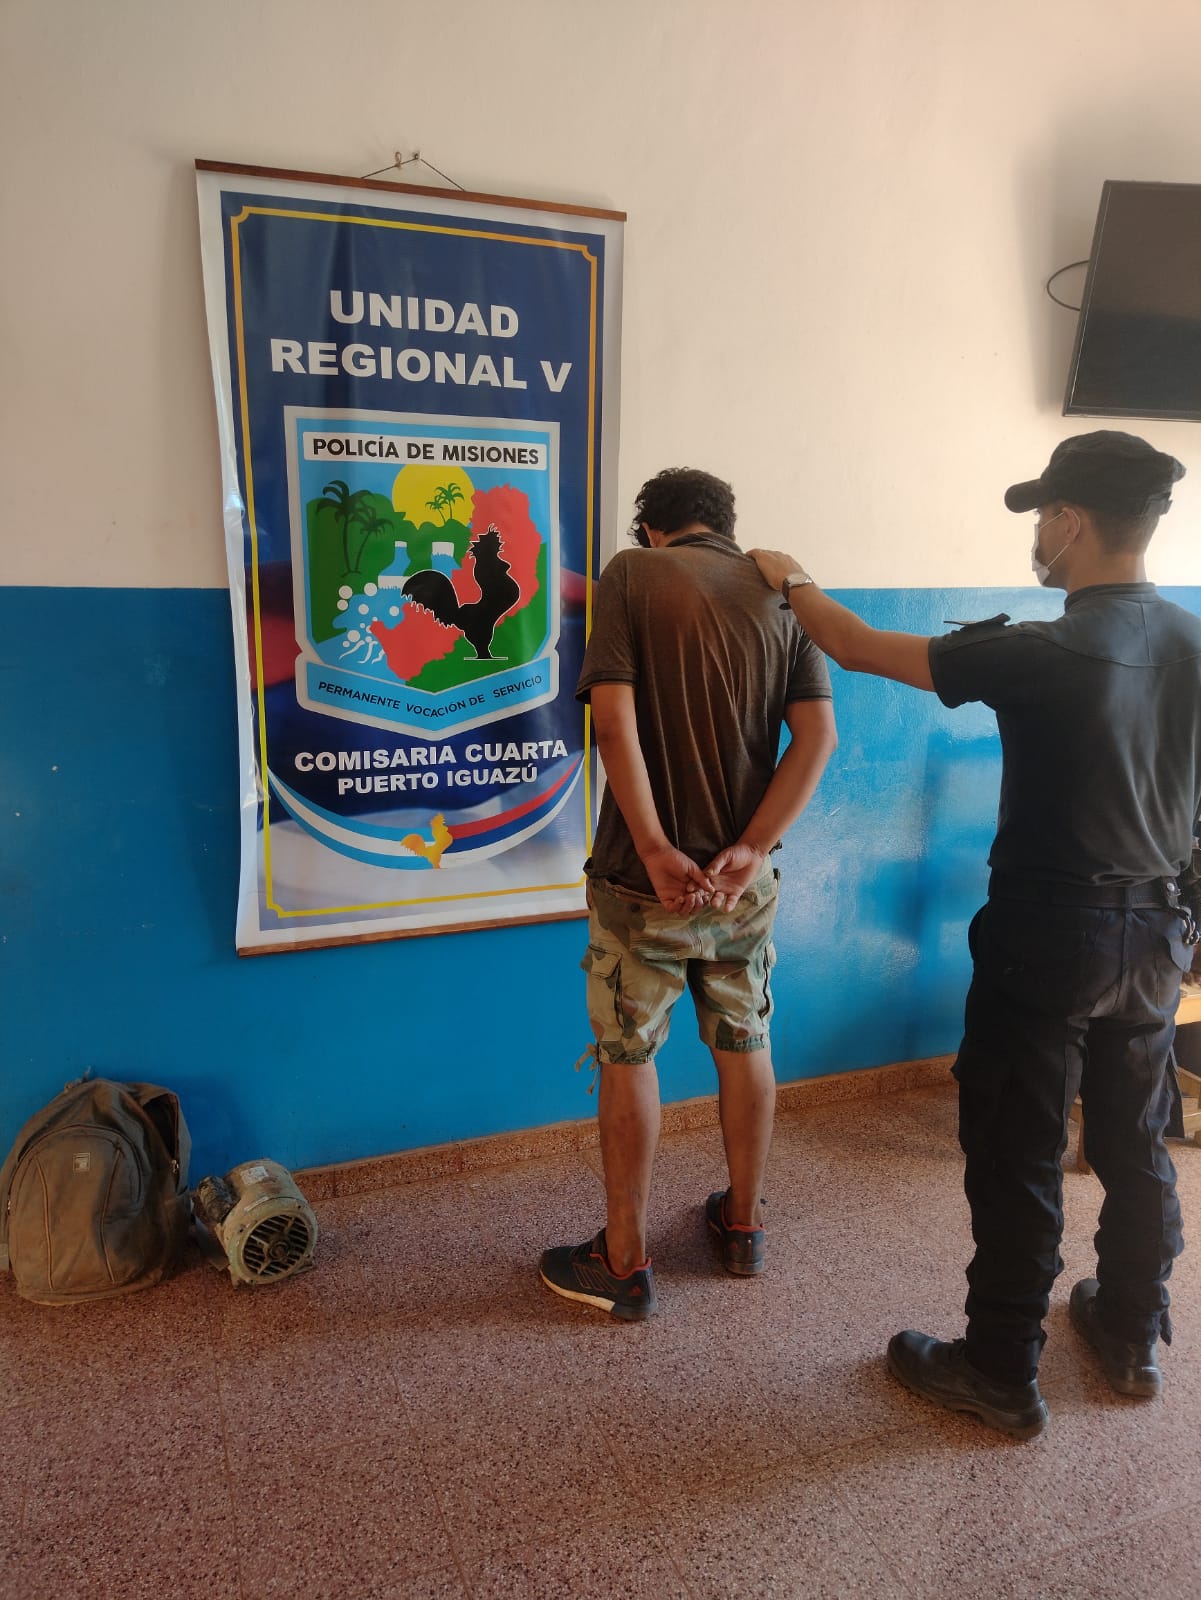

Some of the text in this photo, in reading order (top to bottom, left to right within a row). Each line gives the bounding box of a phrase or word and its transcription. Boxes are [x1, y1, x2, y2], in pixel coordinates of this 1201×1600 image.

[330, 290, 519, 338] UNIDAD
[270, 338, 573, 393] REGIONAL V
[313, 436, 539, 465] POLICÍA DE MISIONES
[318, 681, 401, 710] PERMANENTE
[469, 694, 486, 706] DE
[493, 675, 543, 698] SERVICIO
[294, 739, 568, 771] COMISARIA CUARTA
[337, 763, 538, 795] PUERTO IGUAZÚ
